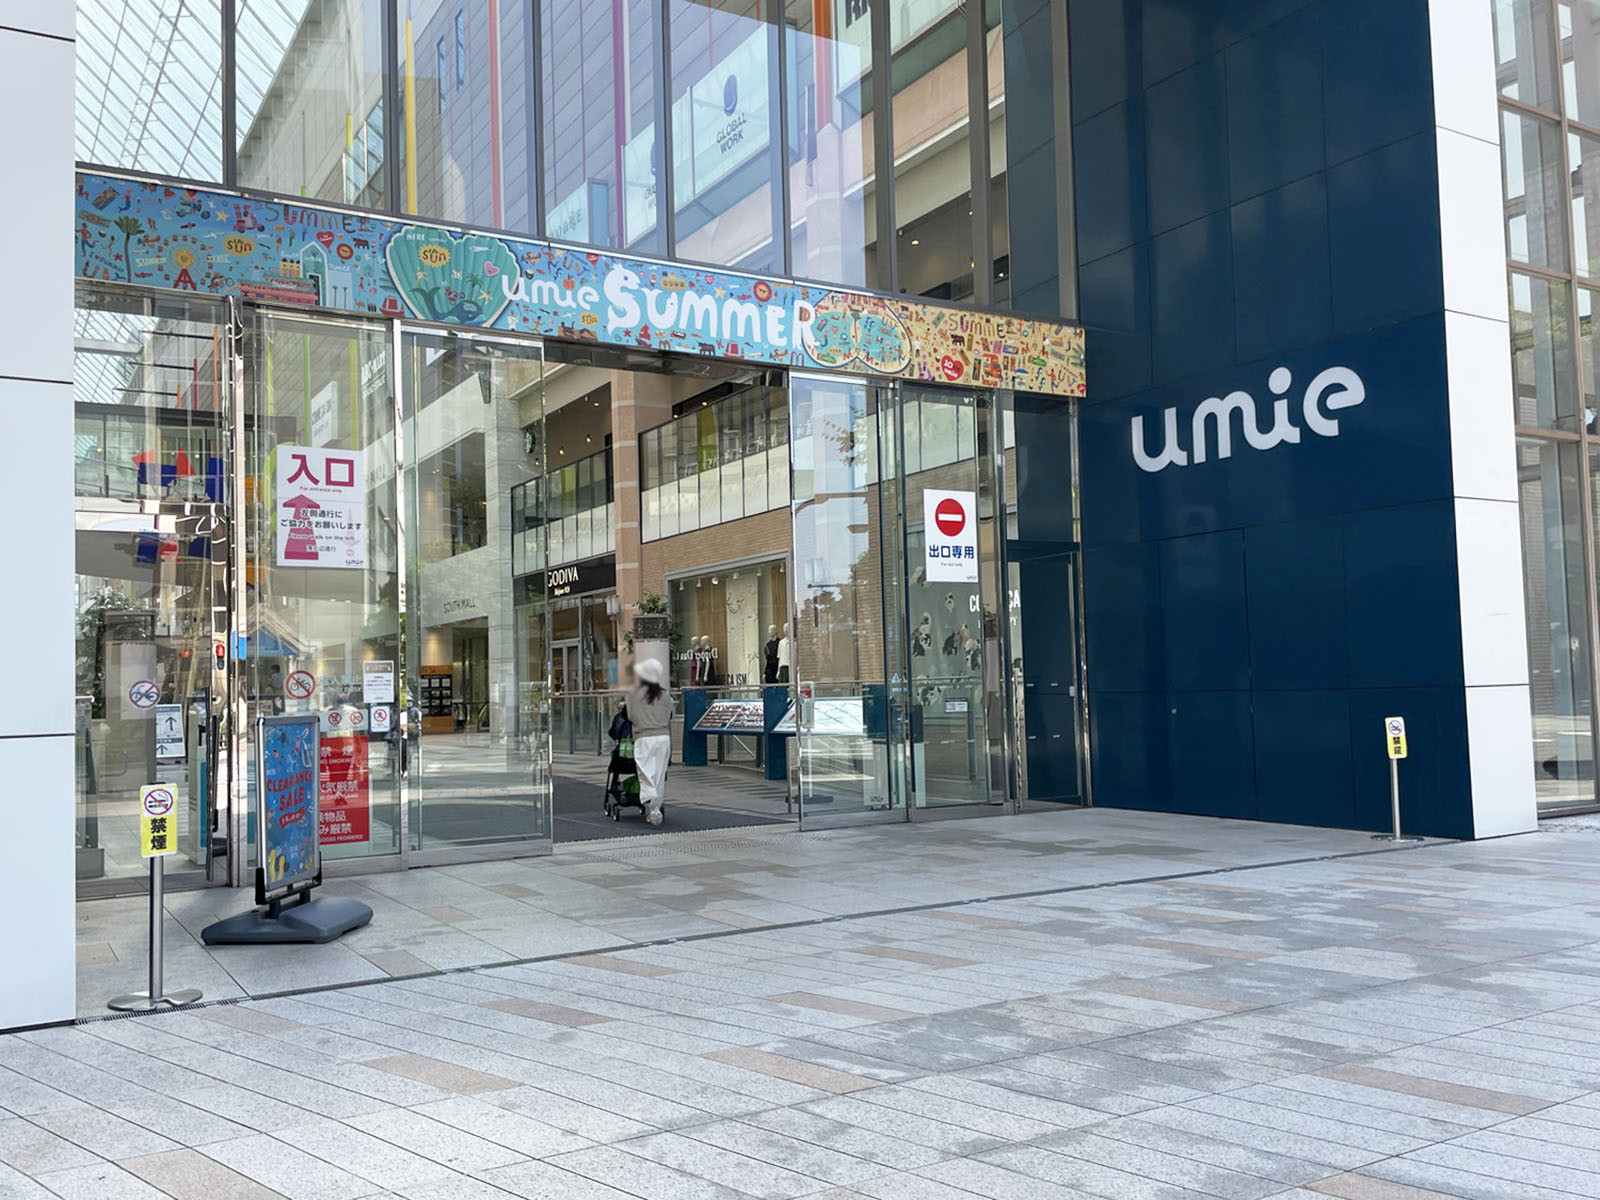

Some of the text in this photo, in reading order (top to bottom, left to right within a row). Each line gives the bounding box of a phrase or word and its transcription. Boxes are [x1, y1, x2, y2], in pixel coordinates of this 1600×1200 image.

[716, 112, 747, 144] GLOBAL
[720, 128, 744, 154] WORK
[501, 263, 820, 351] umie SUMMER
[1131, 366, 1366, 473] umie
[287, 453, 355, 487] 入口
[280, 519, 362, 530] ご協力をお願いします
[301, 509, 343, 519] 左側通行に
[929, 545, 974, 559] 出口専用
[279, 786, 305, 812] SALE
[150, 817, 168, 851] 禁煙
